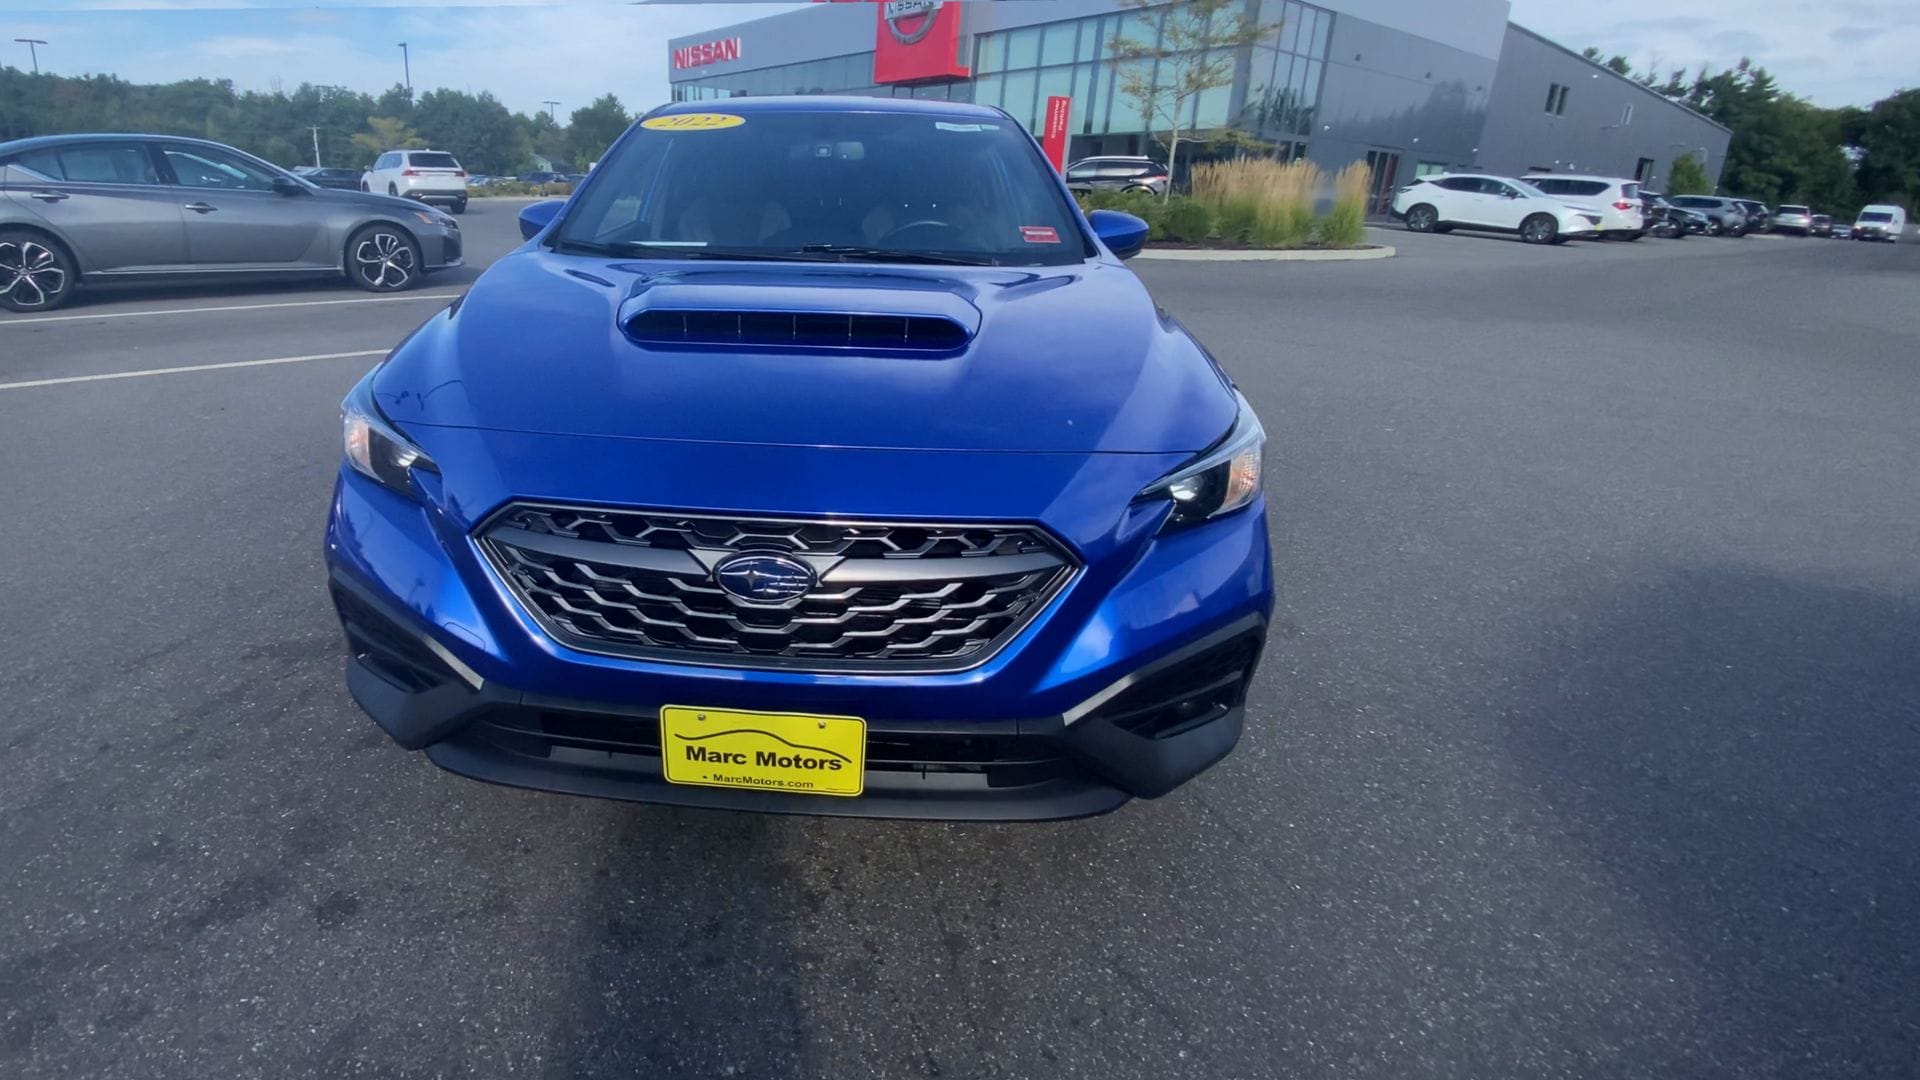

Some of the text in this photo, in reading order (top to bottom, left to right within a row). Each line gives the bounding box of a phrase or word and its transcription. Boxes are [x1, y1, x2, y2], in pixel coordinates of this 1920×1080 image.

[673, 36, 739, 69] NISSAN
[655, 116, 728, 127] 2022
[686, 745, 842, 771] Marc Motors
[713, 773, 814, 789] MarcMotors.com
